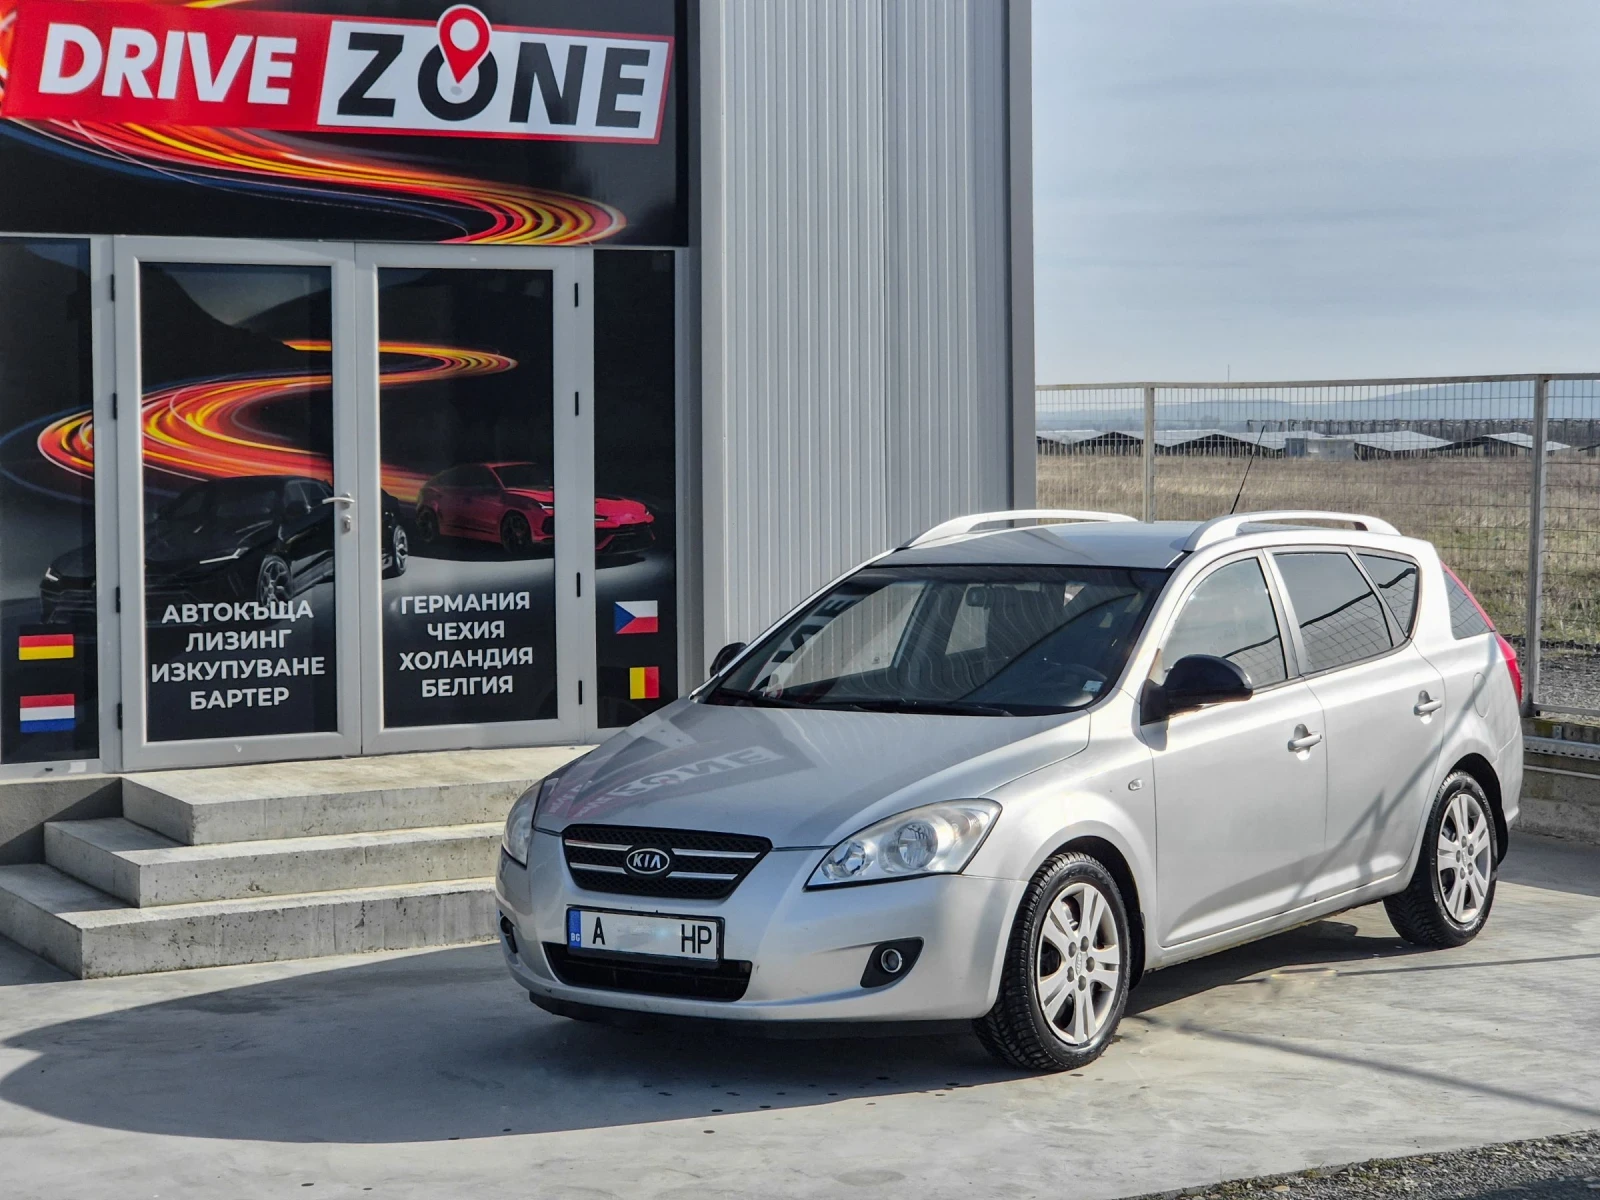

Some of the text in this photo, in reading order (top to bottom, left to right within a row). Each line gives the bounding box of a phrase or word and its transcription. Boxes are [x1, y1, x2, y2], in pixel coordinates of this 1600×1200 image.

[38, 22, 652, 129] DRIVE ZONE
[162, 600, 314, 624] АВТОКЪЩА
[401, 591, 530, 615] ГЕРМАНИЯ
[185, 629, 292, 652] ЛИЗИНГ
[427, 620, 505, 641] ЧЕХИЯ
[151, 657, 326, 683] ИЗКУПУВАНЕ
[399, 647, 533, 671] ХОЛАНДИЯ
[190, 687, 290, 710] БАРТЕР
[421, 675, 514, 698] БЕЛГИЯ
[633, 855, 661, 869] KIA
[570, 932, 581, 942] BG
[680, 923, 712, 954] HP
